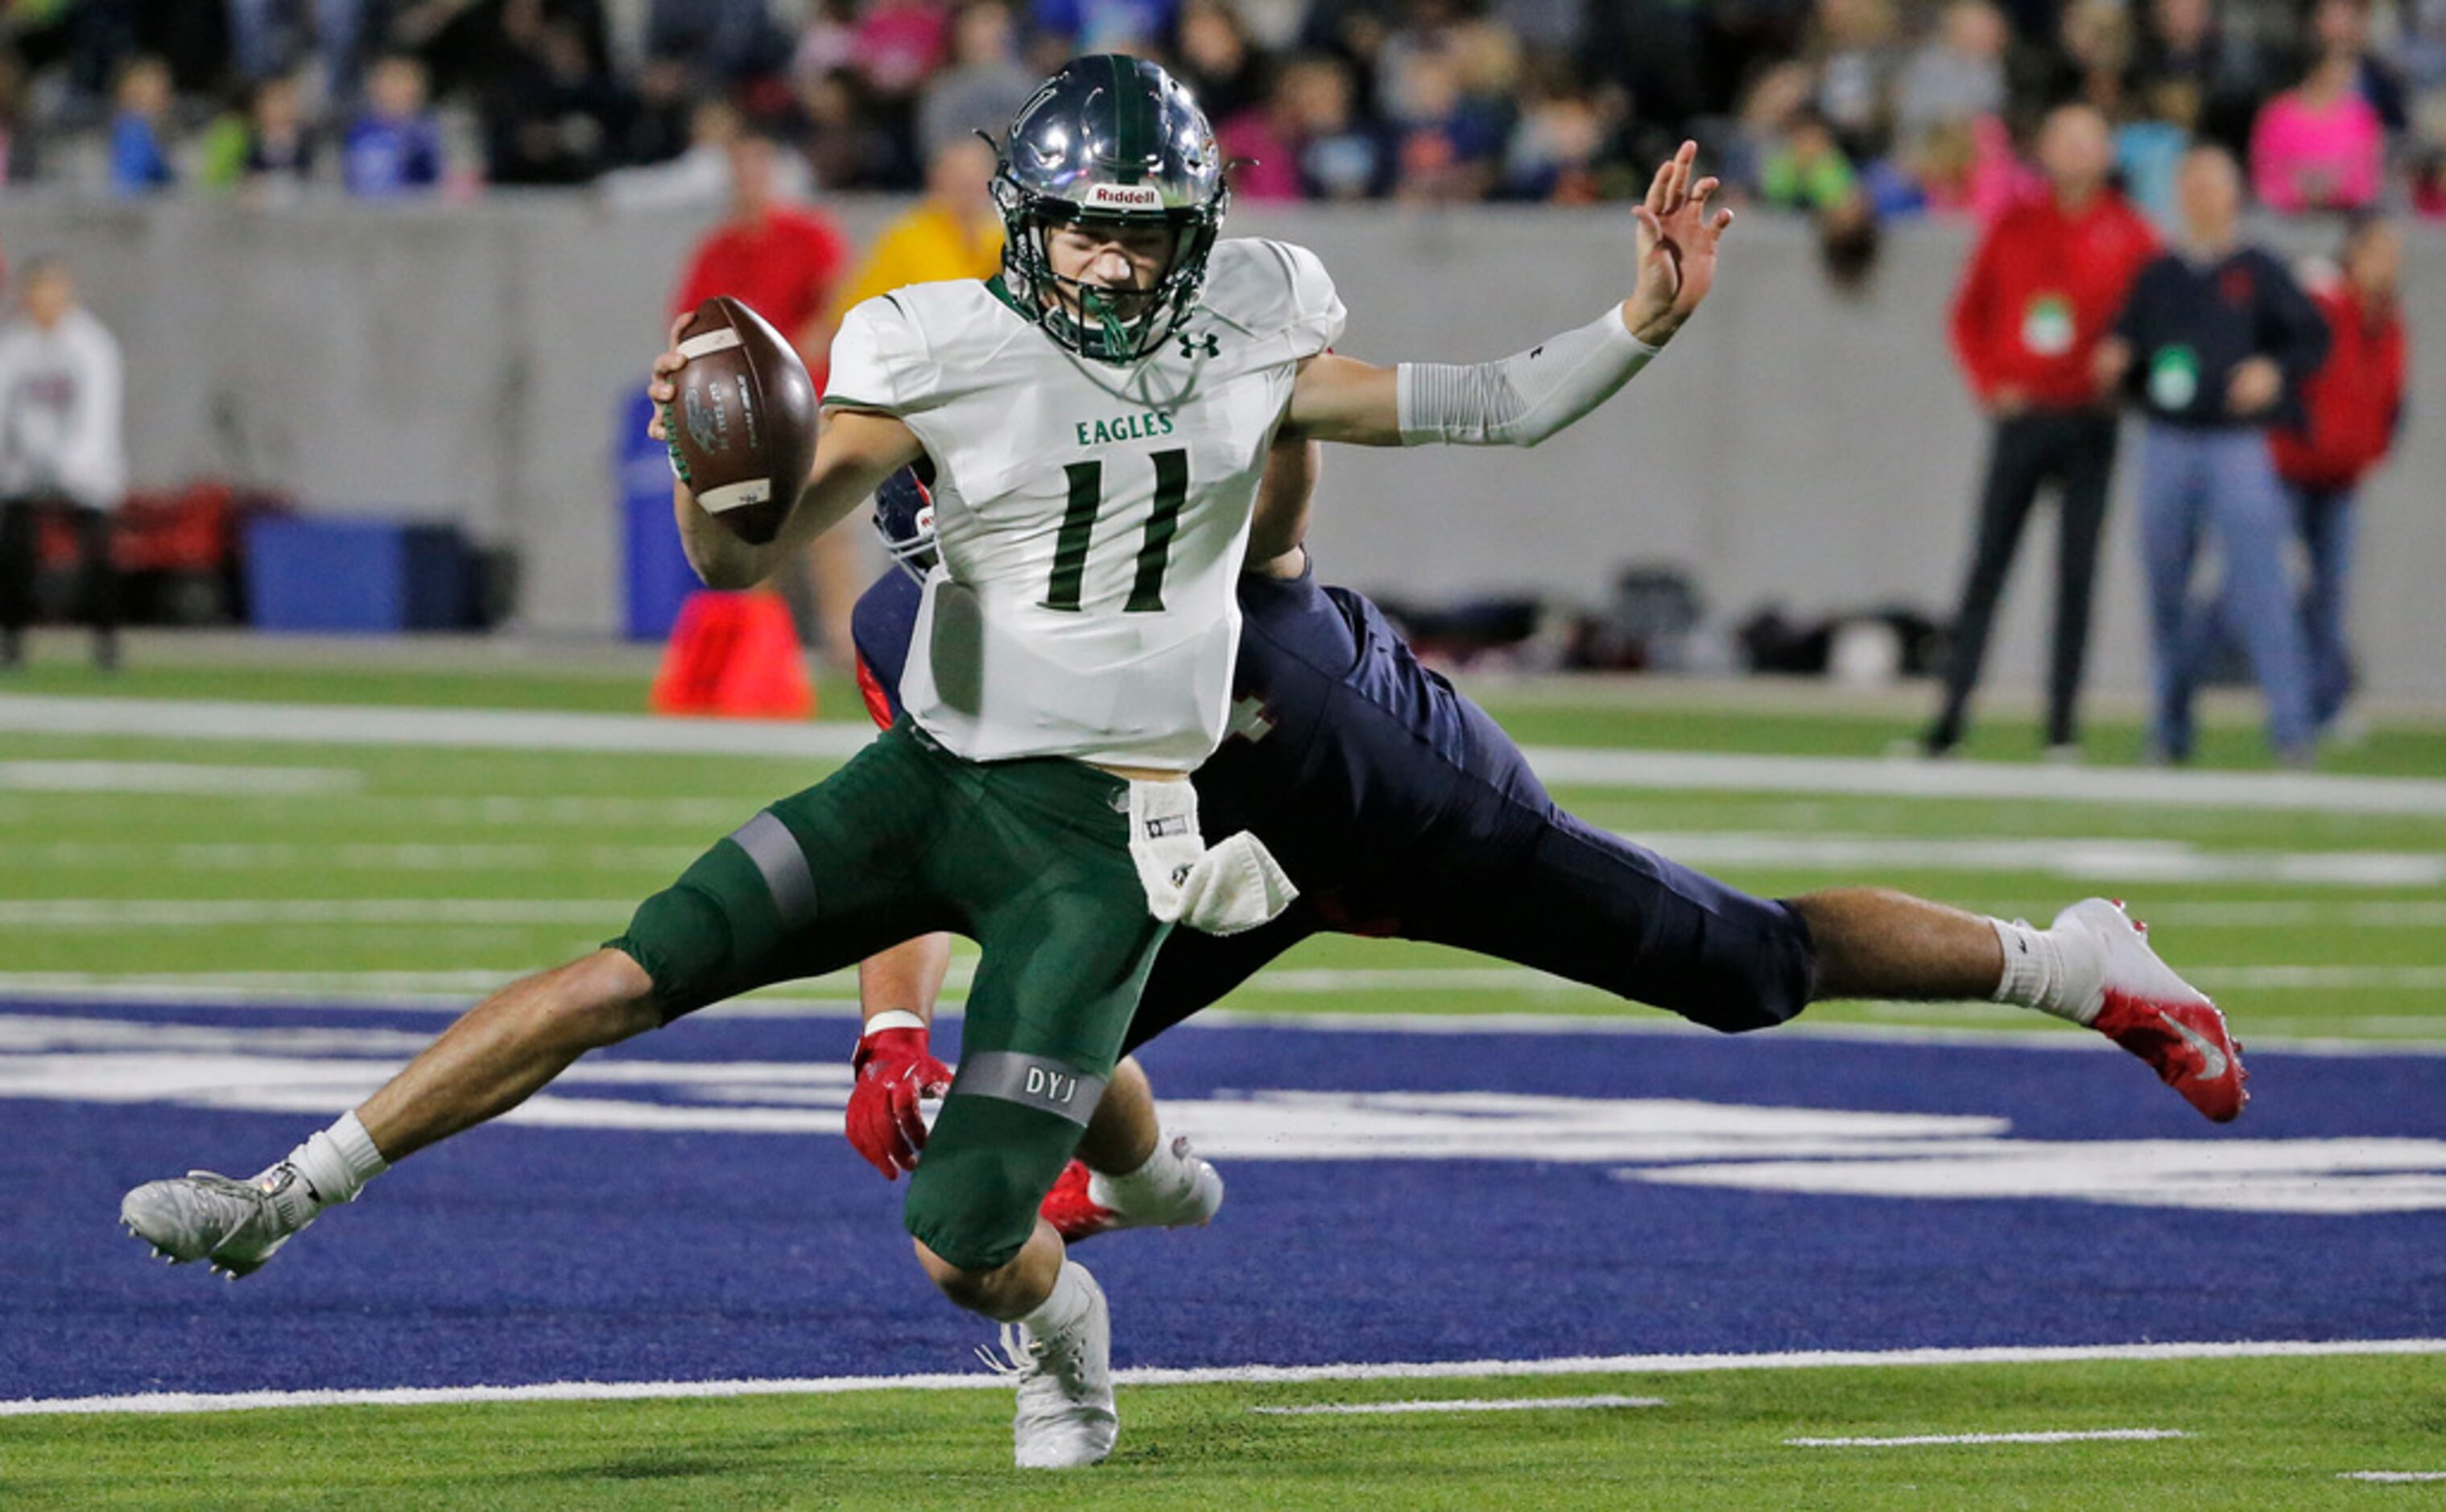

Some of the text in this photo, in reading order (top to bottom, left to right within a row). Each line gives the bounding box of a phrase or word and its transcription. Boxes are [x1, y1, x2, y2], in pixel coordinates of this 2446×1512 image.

[1097, 188, 1155, 204] Riddell
[1076, 411, 1173, 444] EAGLES
[1036, 448, 1189, 612] 11
[1027, 1067, 1076, 1103] DYJ
